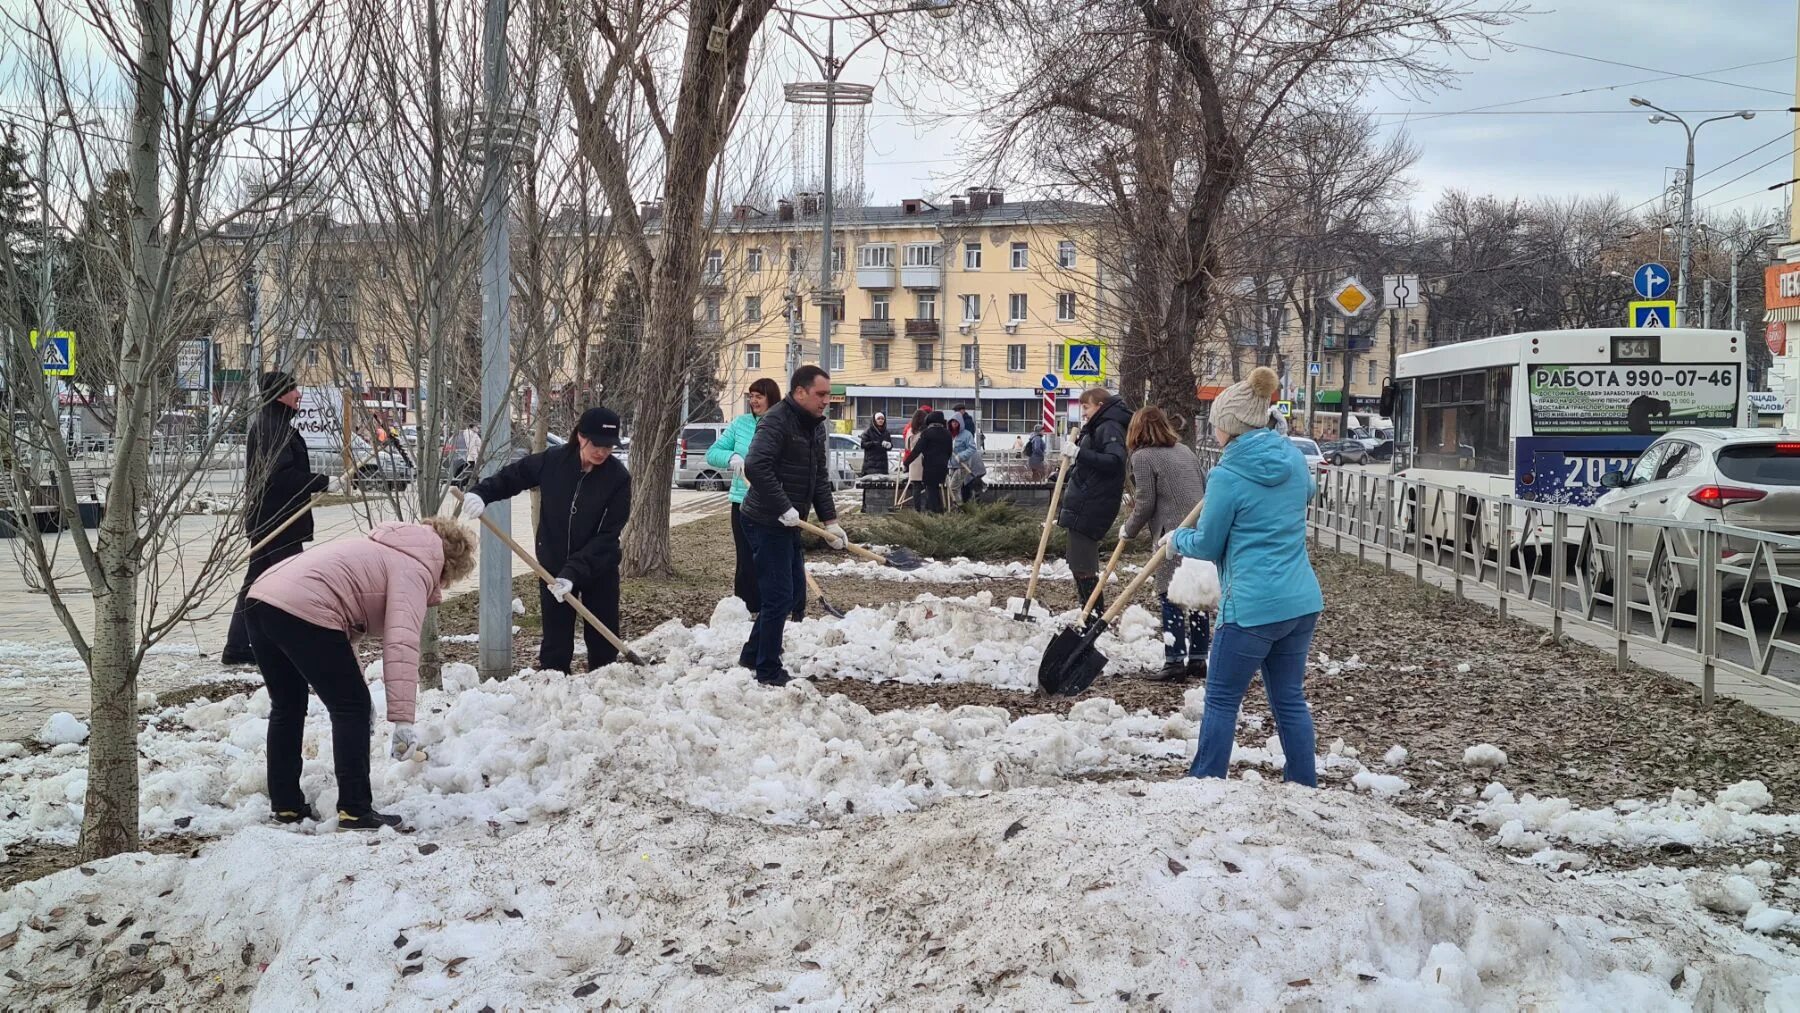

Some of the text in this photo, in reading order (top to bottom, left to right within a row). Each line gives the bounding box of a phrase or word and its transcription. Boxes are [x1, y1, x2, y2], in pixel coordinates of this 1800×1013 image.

[1621, 340, 1647, 357] 34
[1536, 369, 1732, 387] РАБОТА 990-07-46
[1564, 457, 1640, 488] 202
